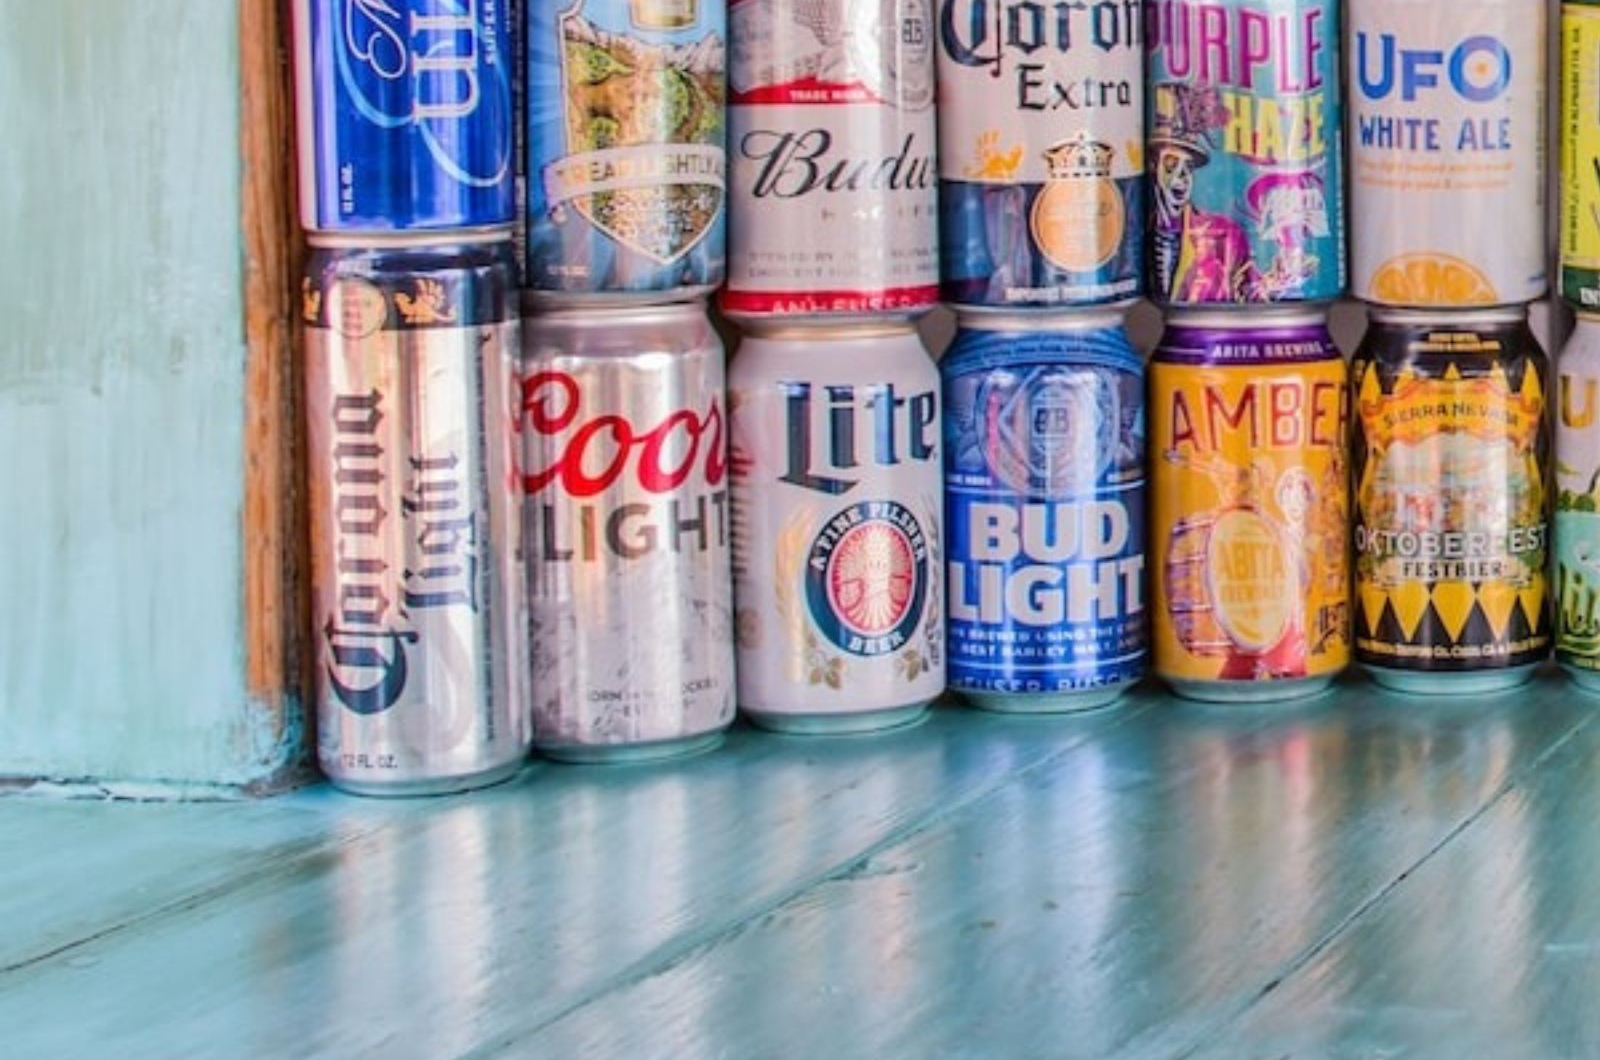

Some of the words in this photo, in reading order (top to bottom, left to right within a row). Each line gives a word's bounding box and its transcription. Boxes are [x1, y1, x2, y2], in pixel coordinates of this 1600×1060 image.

[1016, 62, 1132, 111] Extra
[1356, 31, 1513, 104] UFO
[1358, 113, 1441, 152] WHITE
[1457, 115, 1513, 151] ALE
[1212, 343, 1260, 358] ABITA
[1263, 341, 1324, 357] BREWING
[777, 380, 937, 496] Lite
[325, 388, 420, 717] Corona
[969, 501, 1130, 564] BUD
[1354, 521, 1548, 558] OKTOBERFEST
[949, 552, 1146, 627] LIGHT
[1402, 560, 1503, 579] FESTBIER
